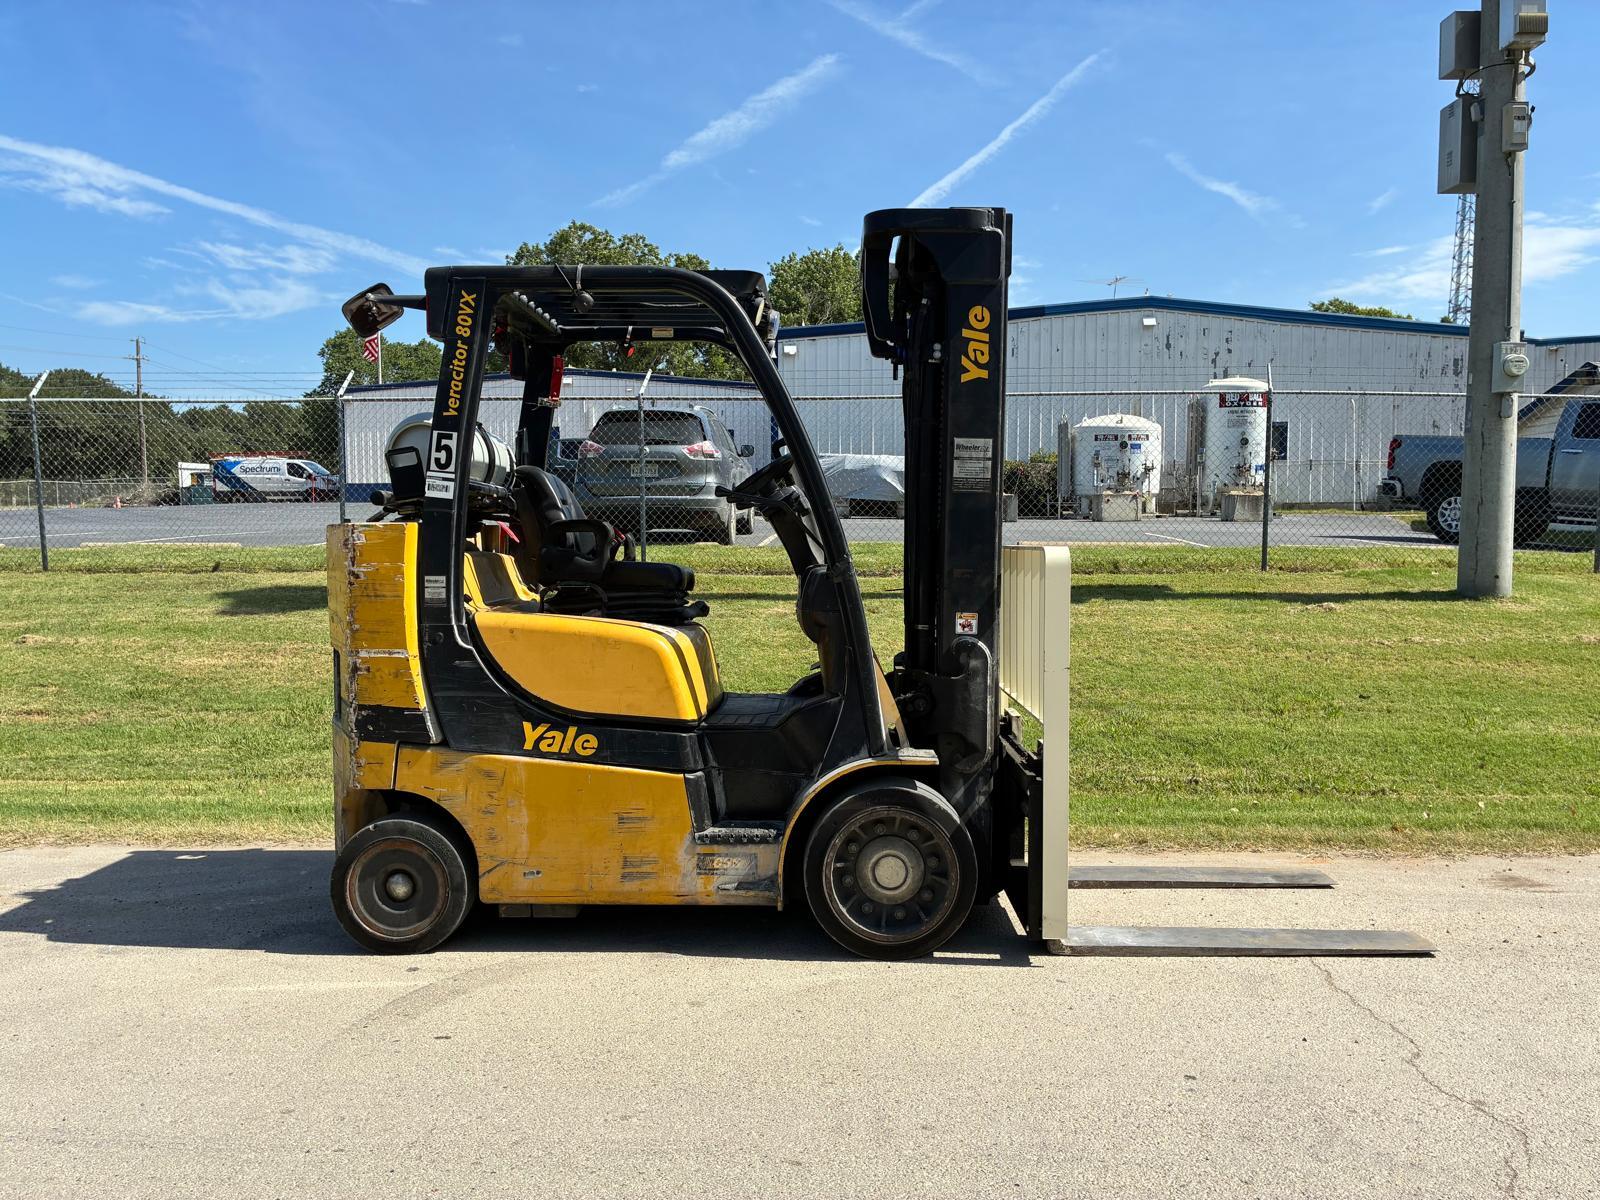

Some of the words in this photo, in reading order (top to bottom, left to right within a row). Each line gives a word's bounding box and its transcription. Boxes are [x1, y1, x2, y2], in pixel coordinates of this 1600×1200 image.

[456, 289, 477, 338] 80VX
[960, 305, 991, 383] Yale
[240, 465, 279, 474] Spectrum
[434, 432, 453, 470] 5
[522, 721, 599, 756] Yale
